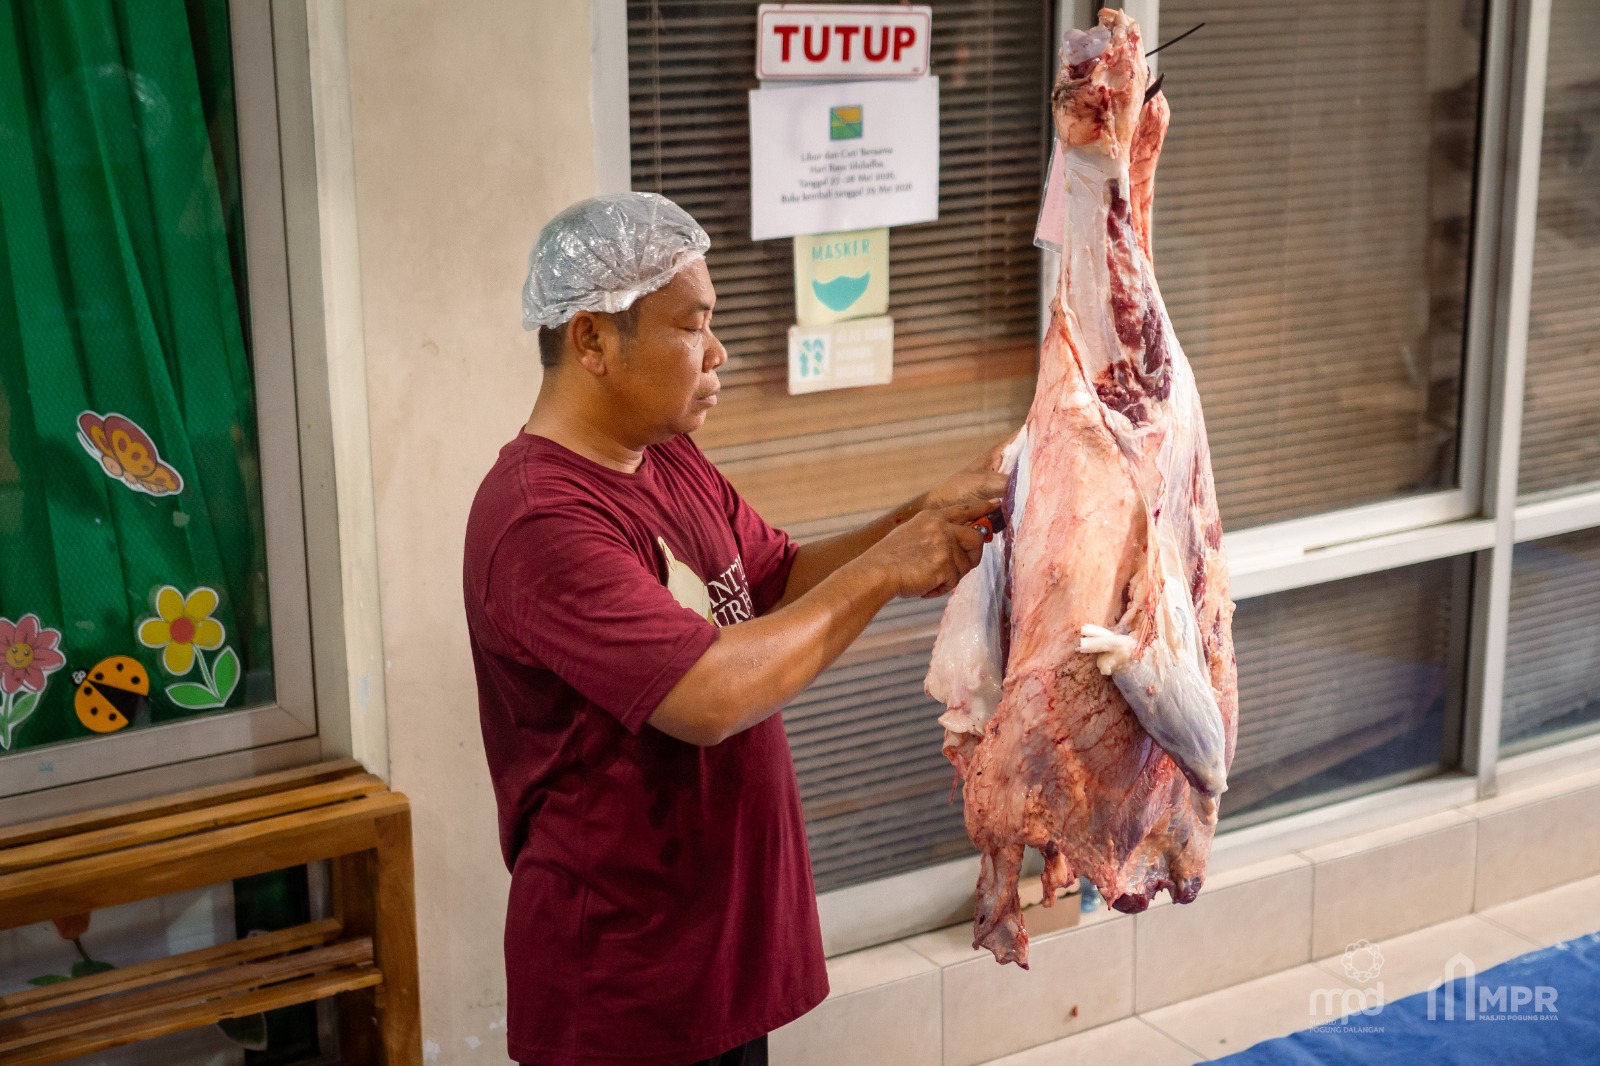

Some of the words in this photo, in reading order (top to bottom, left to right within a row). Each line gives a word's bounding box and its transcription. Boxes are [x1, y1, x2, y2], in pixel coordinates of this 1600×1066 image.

[774, 25, 917, 63] TUTUP
[825, 151, 838, 160] dan
[841, 149, 859, 158] Cuti
[861, 147, 893, 157] Bersama
[810, 165, 826, 173] Hari
[829, 163, 847, 173] Raya
[800, 178, 828, 189] Tanggal
[859, 174, 873, 182] Mei
[781, 194, 801, 203] Buka
[803, 191, 832, 201] kembali
[835, 187, 863, 199] tanggal
[879, 184, 893, 193] Mei
[812, 238, 870, 262] MASKER
